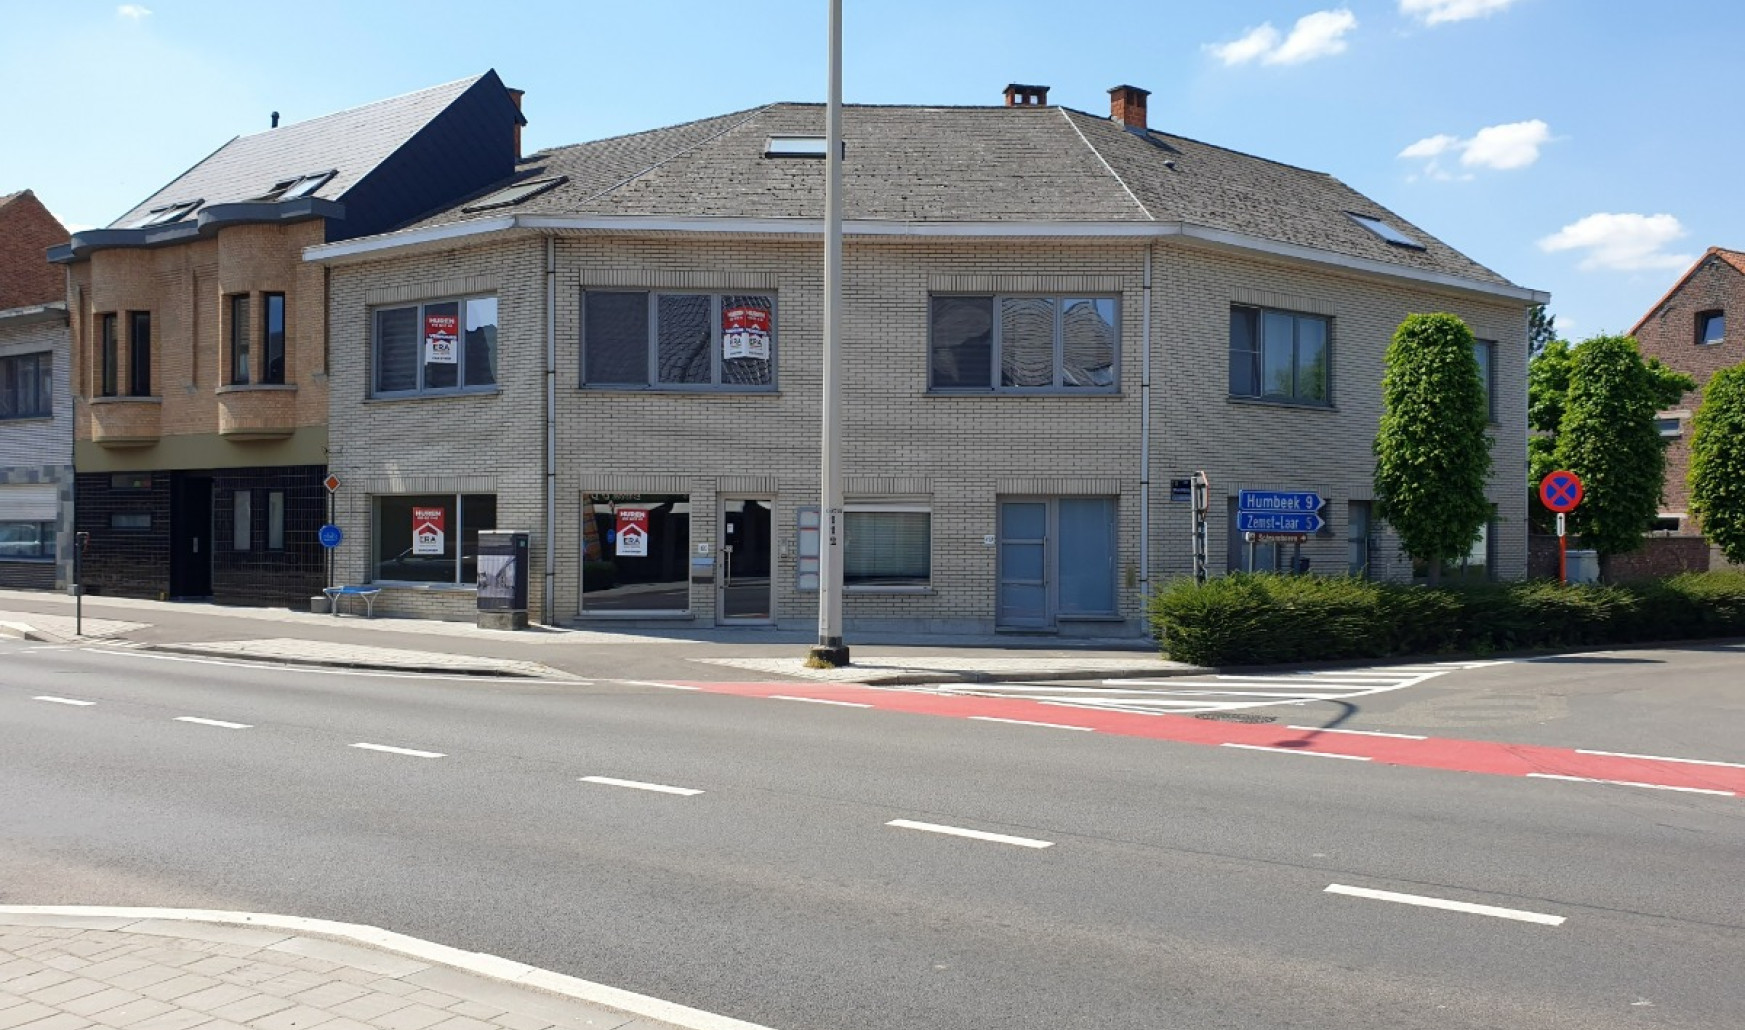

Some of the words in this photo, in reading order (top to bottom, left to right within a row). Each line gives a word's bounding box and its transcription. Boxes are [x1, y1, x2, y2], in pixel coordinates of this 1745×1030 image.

[432, 343, 450, 351] ERA
[1247, 493, 1300, 509] Humbeek
[1305, 495, 1313, 509] 9
[1247, 514, 1299, 530] Zemst-Laar
[1305, 516, 1313, 530] 5
[623, 537, 641, 545] ERA
